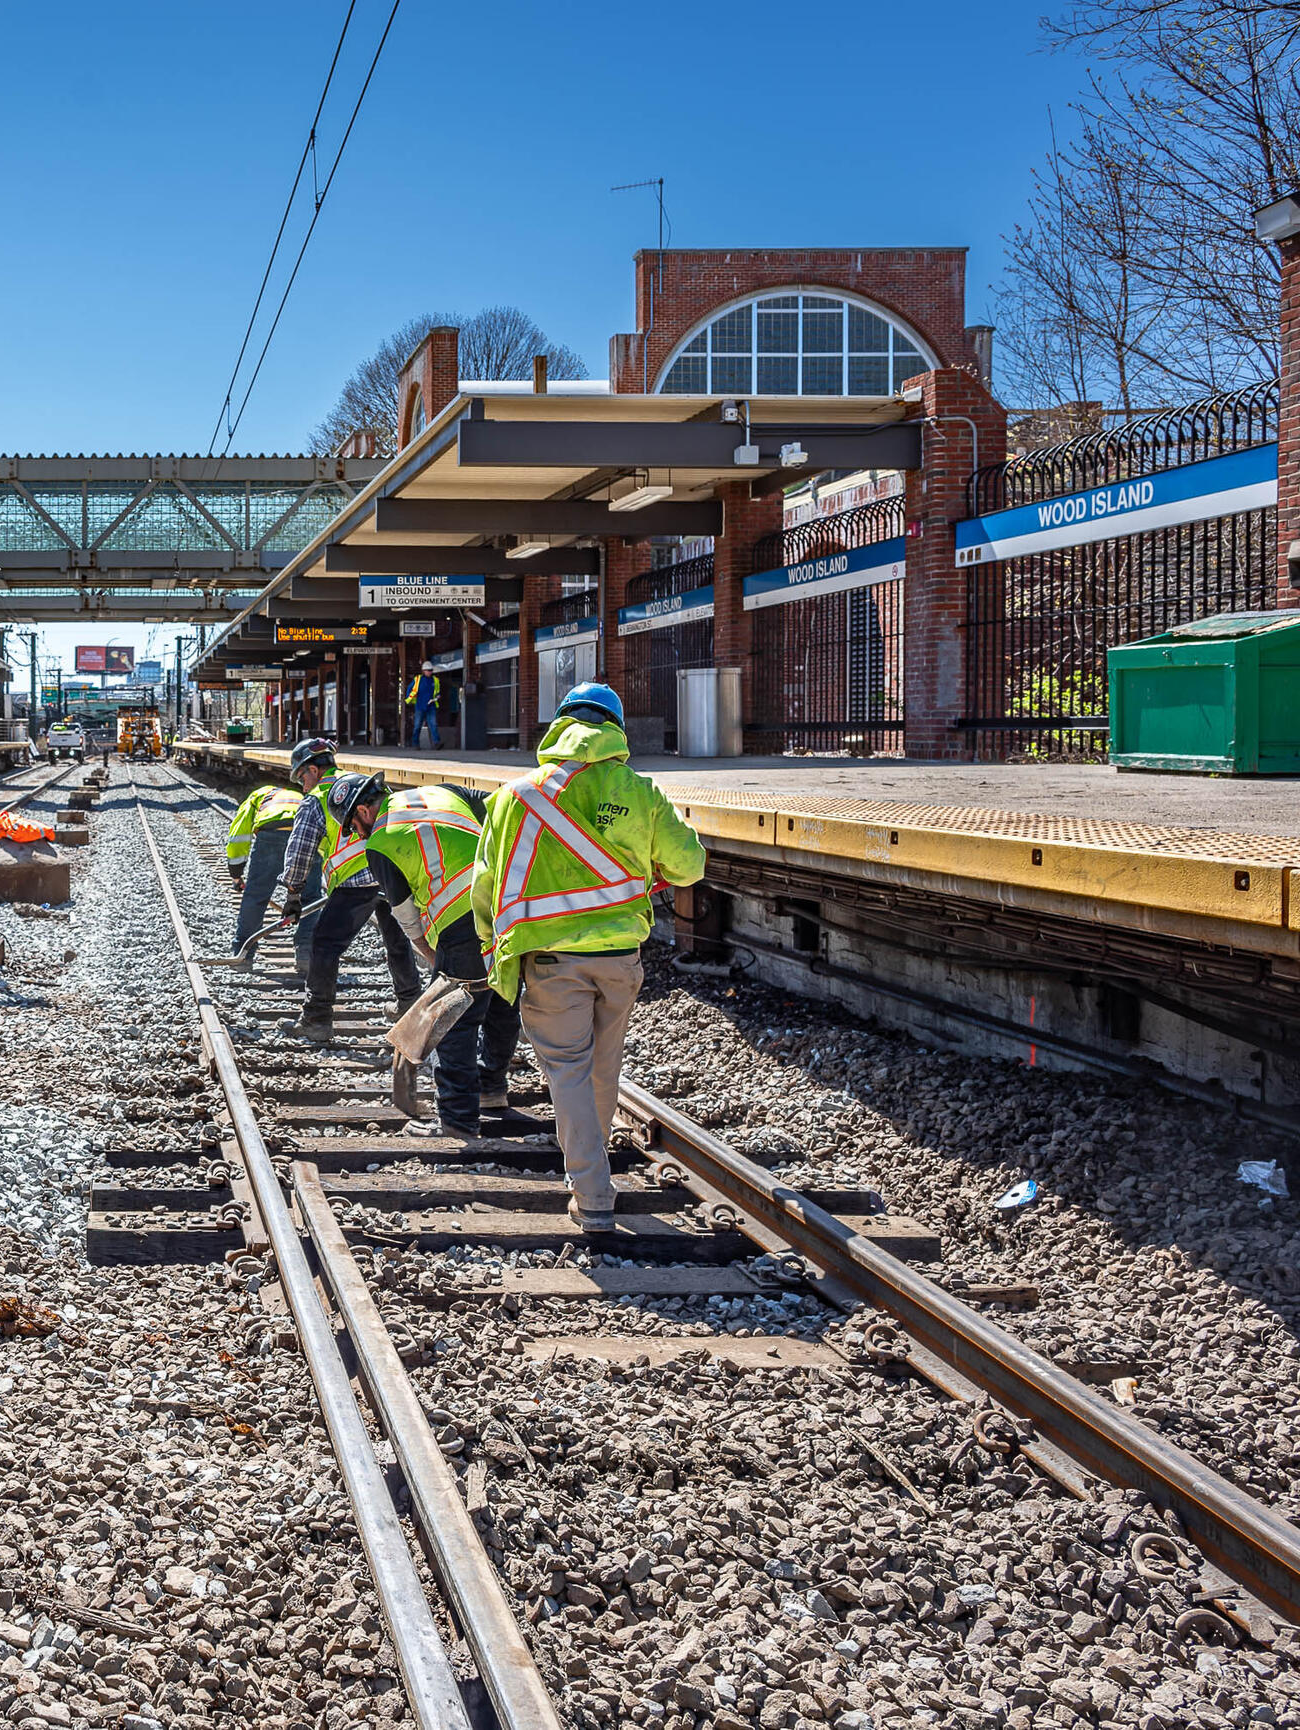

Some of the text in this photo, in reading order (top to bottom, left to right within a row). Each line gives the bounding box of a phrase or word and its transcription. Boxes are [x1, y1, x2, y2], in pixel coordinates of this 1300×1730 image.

[1038, 481, 1153, 528] WOOD ISLAND
[788, 555, 847, 584] WOOD ISLAND
[397, 576, 448, 585] BLUE LINE
[367, 589, 375, 604] 1
[385, 587, 431, 595] INBOUND
[645, 596, 682, 617] WOOD ISLAND
[278, 627, 367, 635] No Blue Line 2:32
